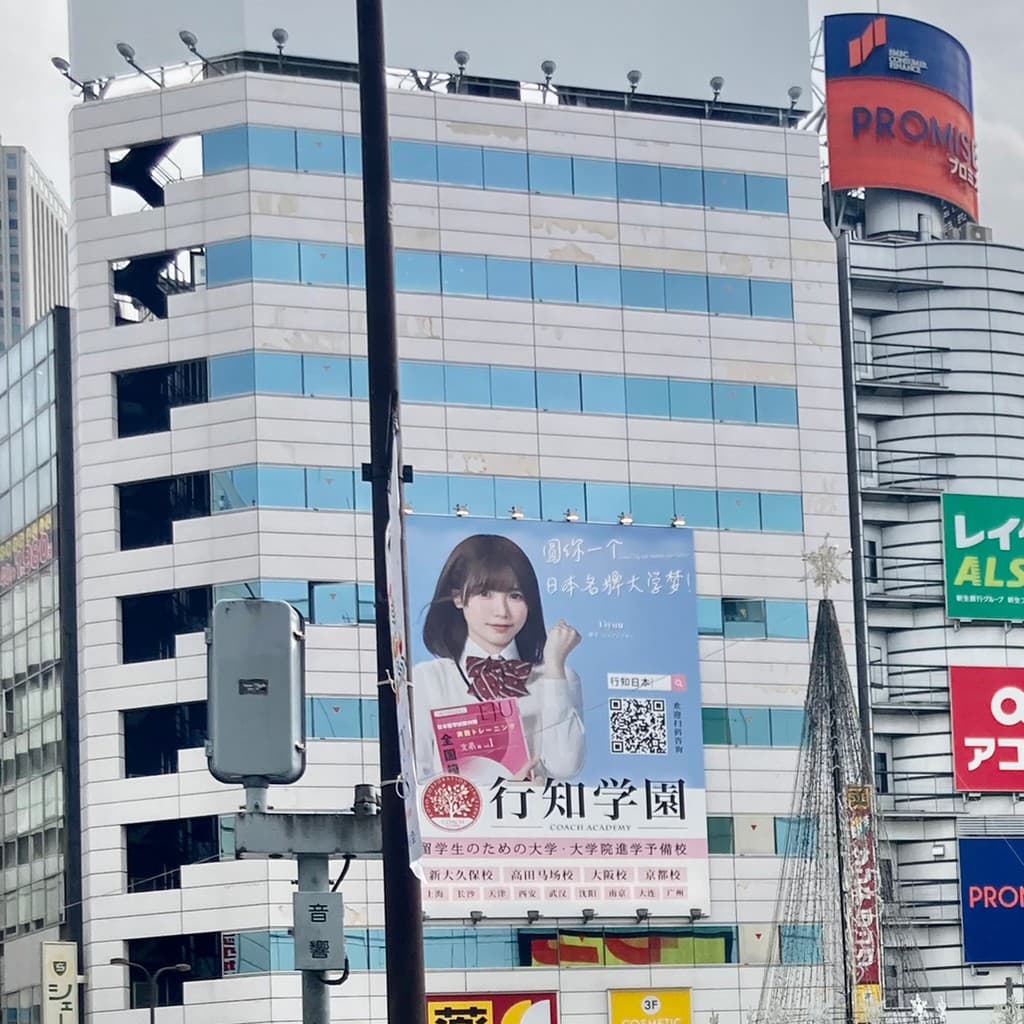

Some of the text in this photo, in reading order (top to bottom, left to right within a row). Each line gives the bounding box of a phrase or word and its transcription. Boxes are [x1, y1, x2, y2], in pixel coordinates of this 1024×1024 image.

[489, 777, 686, 821] 行知学園
[549, 824, 632, 832] COACH ACADEMY
[591, 869, 628, 882] 大阪校
[645, 869, 682, 882] 京都校
[308, 903, 330, 960] 音響
[643, 1000, 659, 1010] 3F
